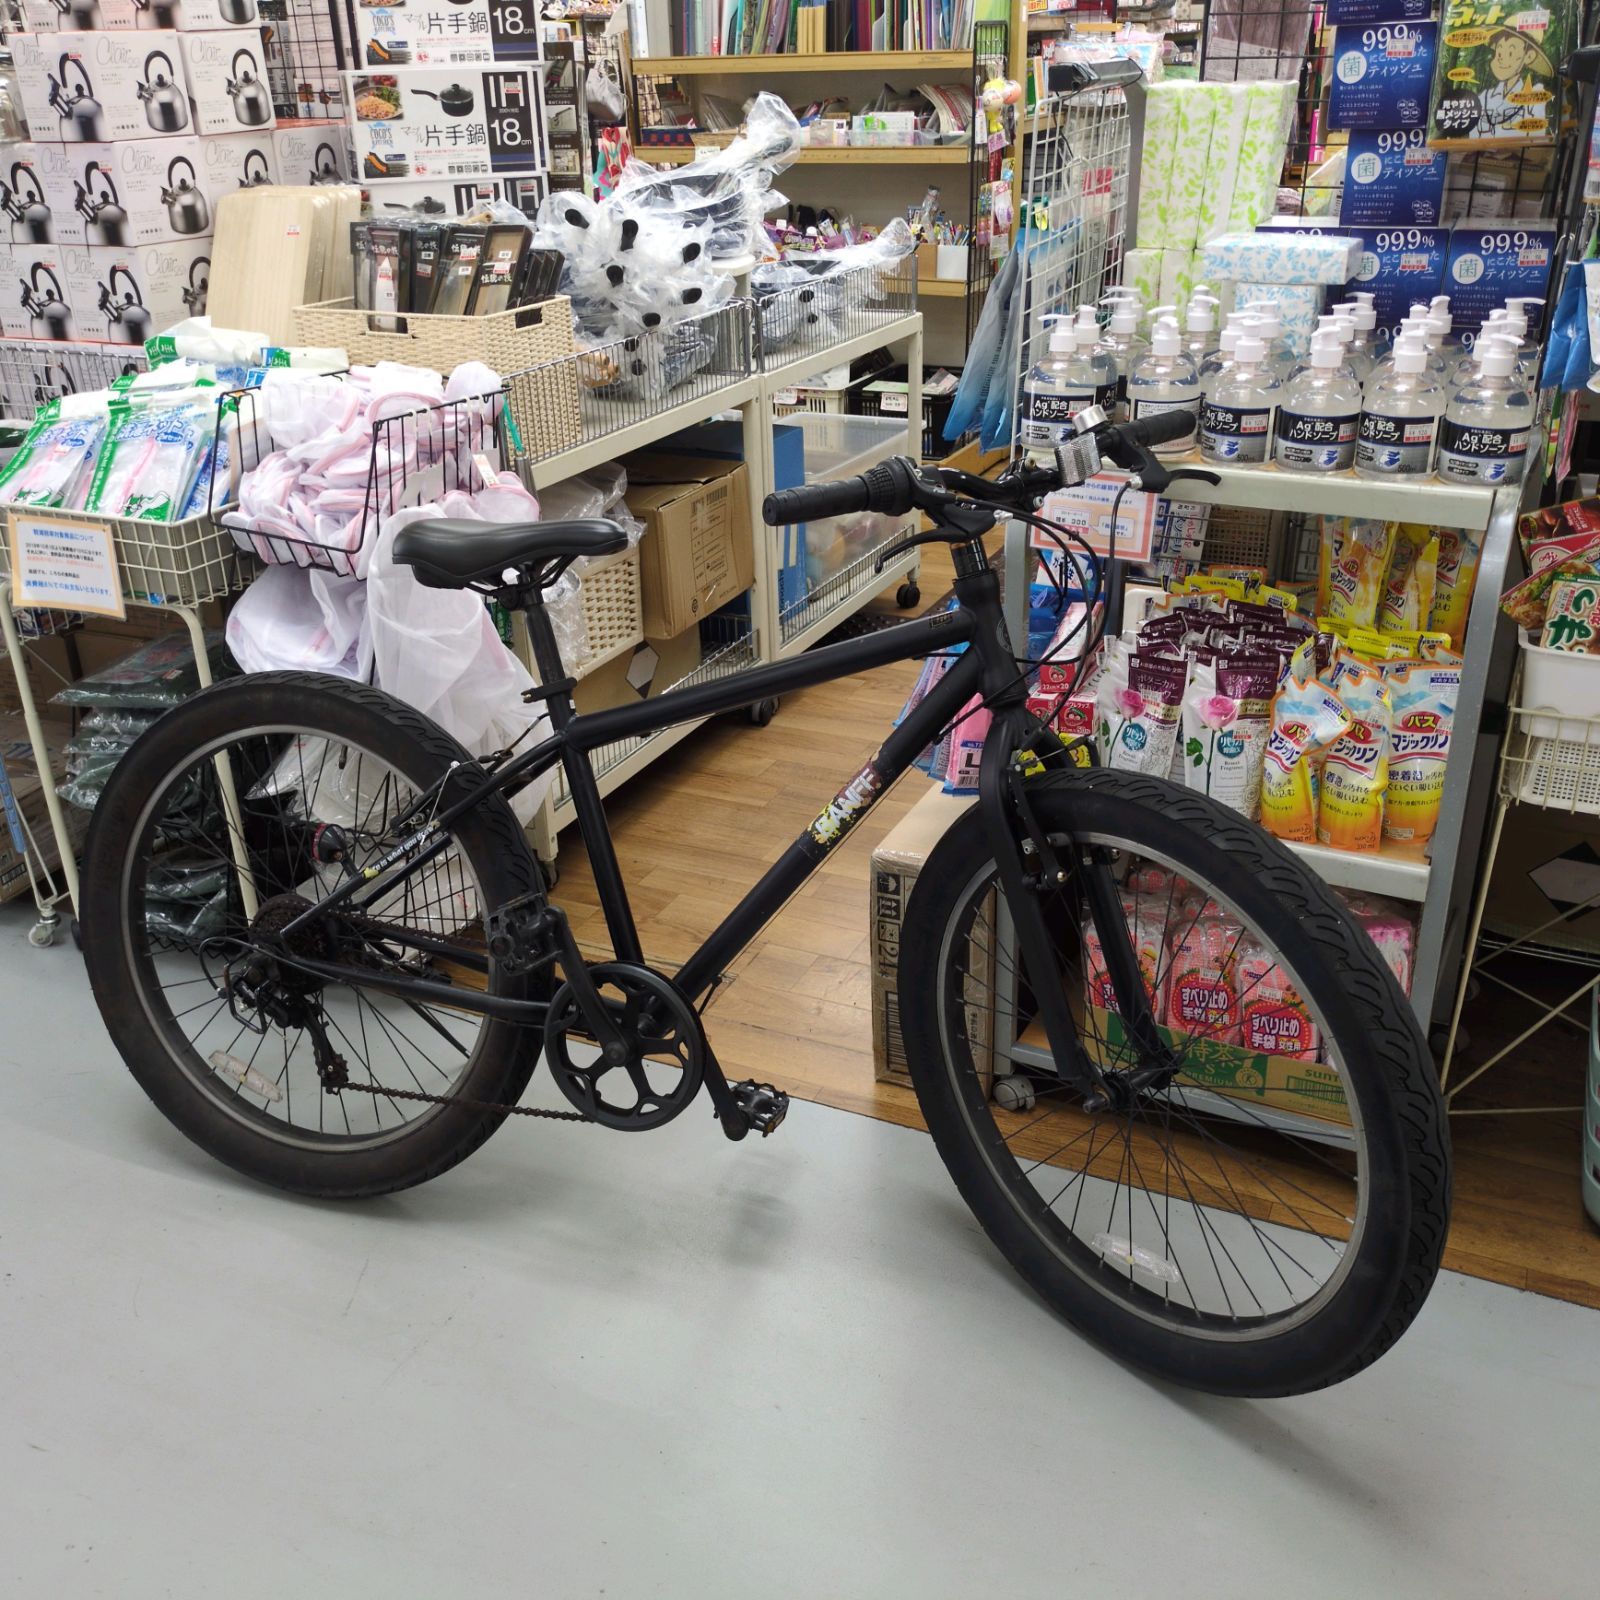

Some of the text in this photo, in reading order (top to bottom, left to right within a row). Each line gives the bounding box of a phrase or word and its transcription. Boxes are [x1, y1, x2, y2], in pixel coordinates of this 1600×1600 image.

[428, 12, 489, 34] 片手鍋
[1448, 5, 1504, 27] ネット
[1362, 24, 1423, 52] 999%
[1343, 57, 1361, 78] 菌
[1368, 62, 1422, 78] ティッシュ
[1443, 100, 1475, 109] 見やすい
[1443, 119, 1470, 129] タイプ
[426, 124, 486, 146] 片手鍋
[1377, 129, 1424, 154] 999
[1358, 157, 1376, 178] 菌
[1383, 166, 1437, 179] ティッシュ
[1376, 229, 1435, 253] 99.9%
[1481, 231, 1543, 255] 99.9%
[1459, 258, 1478, 278] 菌
[1485, 269, 1541, 281] ティッシュ
[1289, 429, 1338, 441] ハンドソープ
[1454, 441, 1507, 454] ハンドソープ
[1407, 715, 1437, 728] バス
[1331, 738, 1379, 763] ジックリン
[1391, 733, 1449, 752] マジックリン
[1182, 988, 1228, 1010] すべり止め
[1252, 1014, 1300, 1037] すべり止め
[1252, 1032, 1301, 1051] 手袋 女性用
